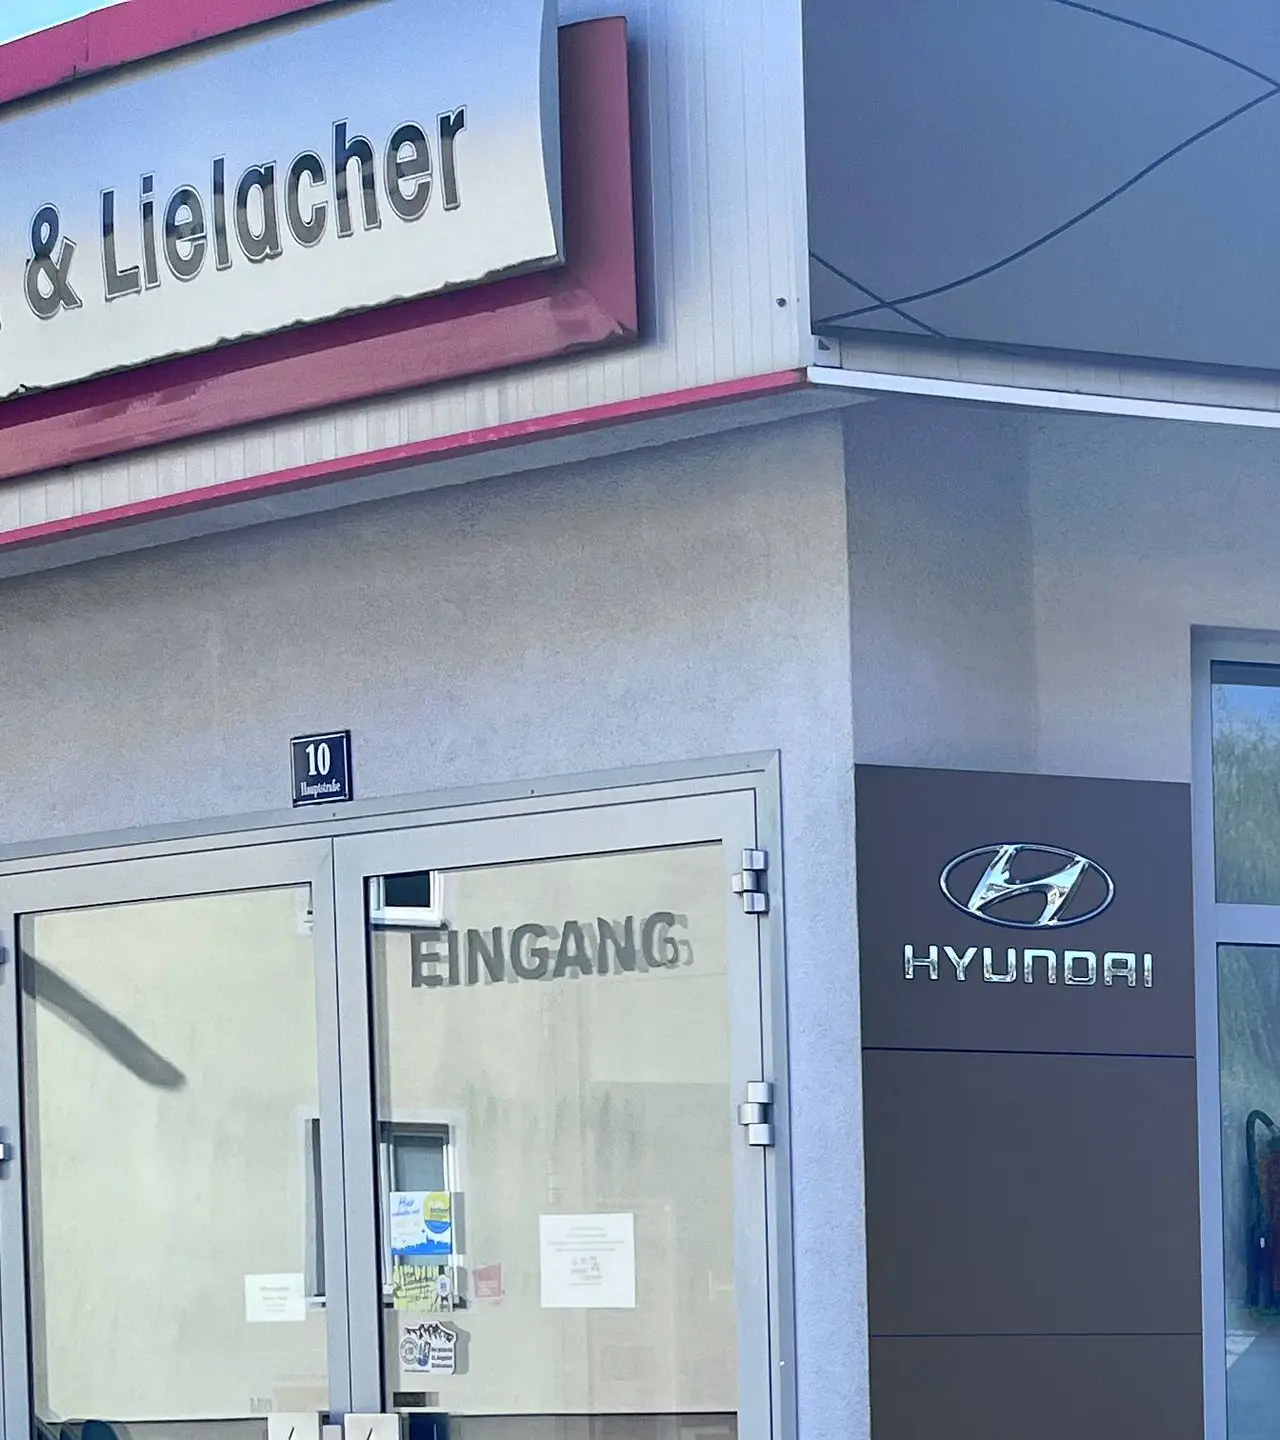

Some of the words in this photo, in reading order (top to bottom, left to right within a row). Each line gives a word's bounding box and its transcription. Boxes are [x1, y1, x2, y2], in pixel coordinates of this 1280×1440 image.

[23, 203, 82, 319] &
[100, 105, 466, 302] Lielacher
[305, 742, 331, 776] 10
[410, 911, 680, 988] EINGANG
[903, 944, 1153, 988] HYUNDAI
